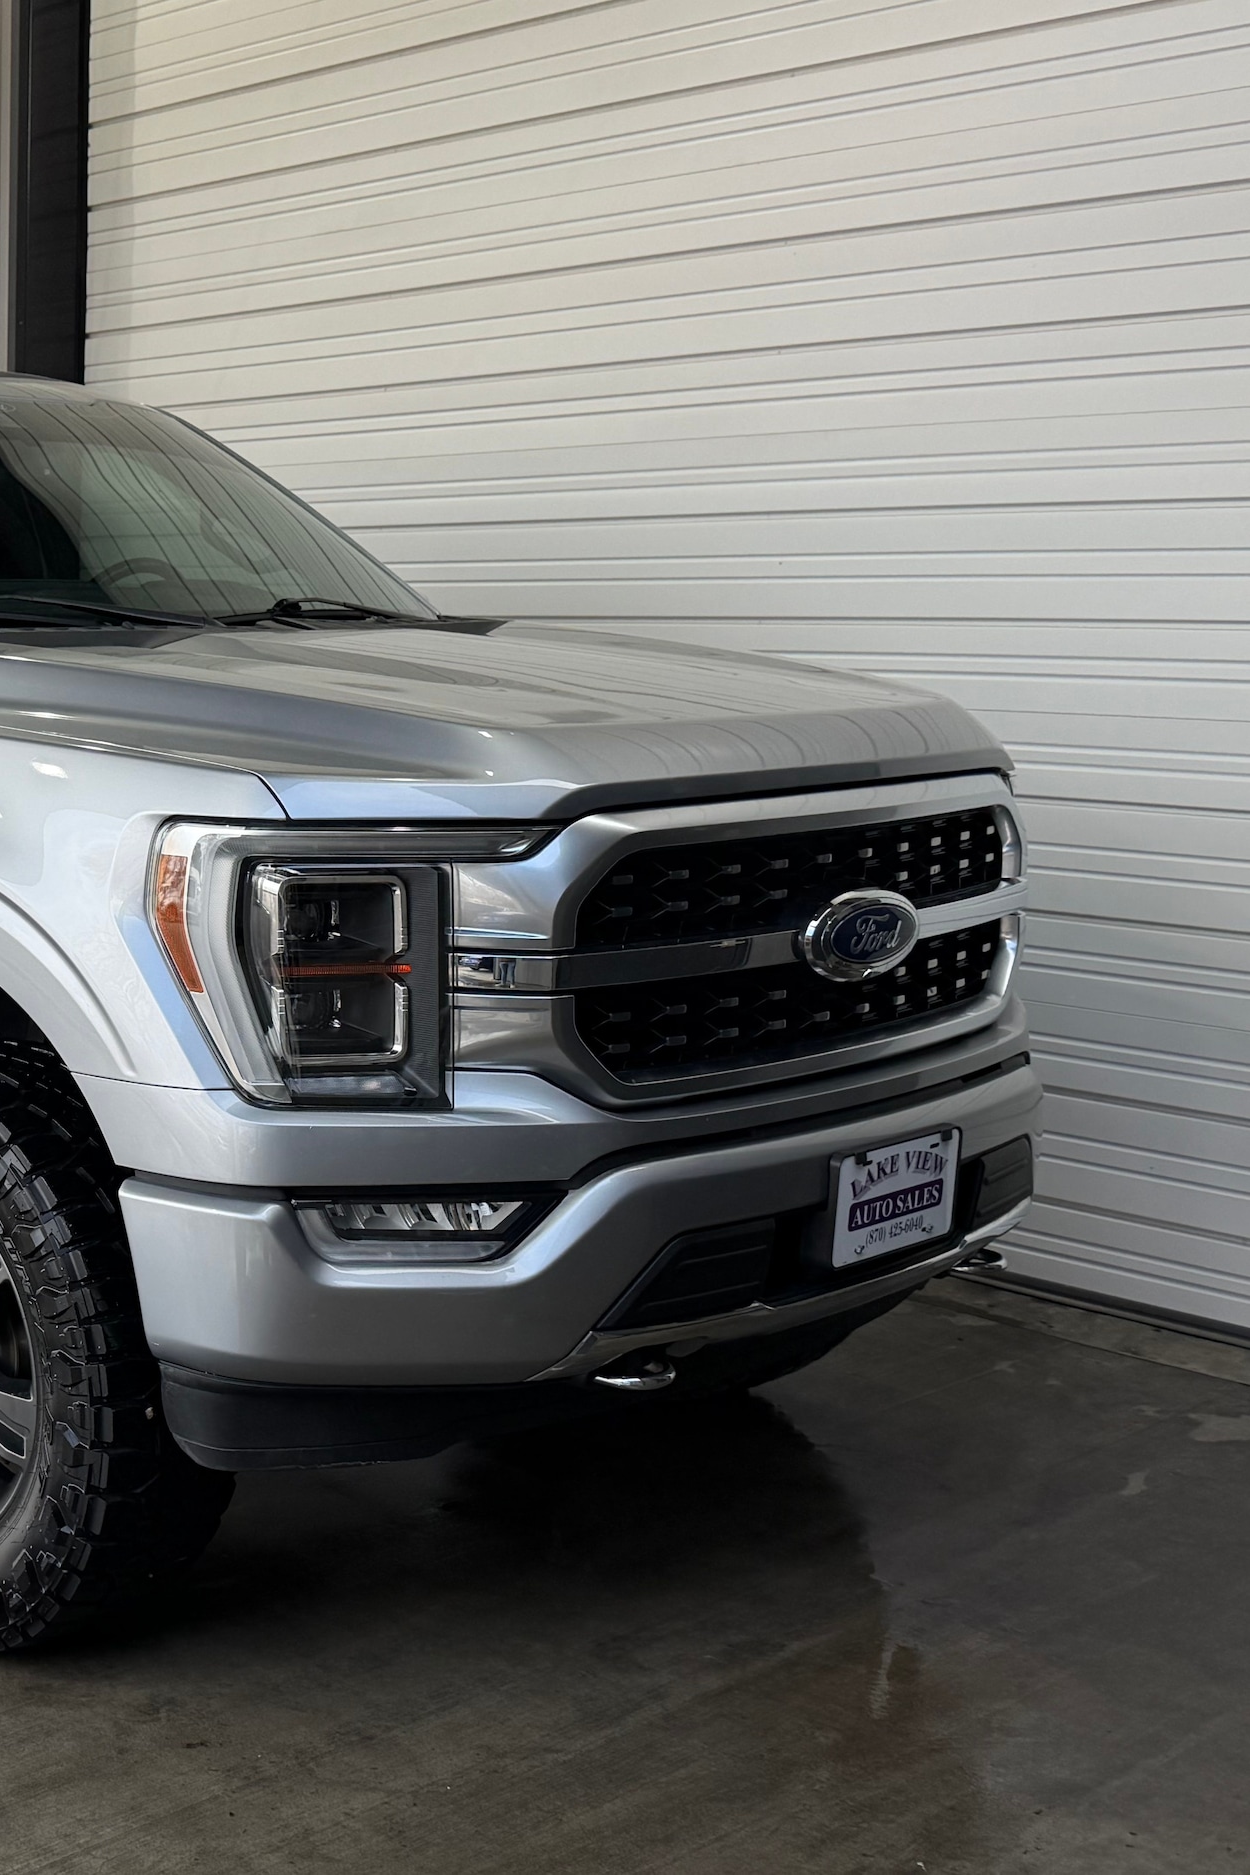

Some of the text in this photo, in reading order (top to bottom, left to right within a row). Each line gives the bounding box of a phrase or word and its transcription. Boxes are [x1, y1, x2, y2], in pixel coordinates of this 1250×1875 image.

[851, 913, 902, 955] Ford
[850, 1150, 949, 1200] LAKE VIEW
[851, 1184, 940, 1227] AUTO SALES
[865, 1215, 924, 1248] (870) 425-6040
